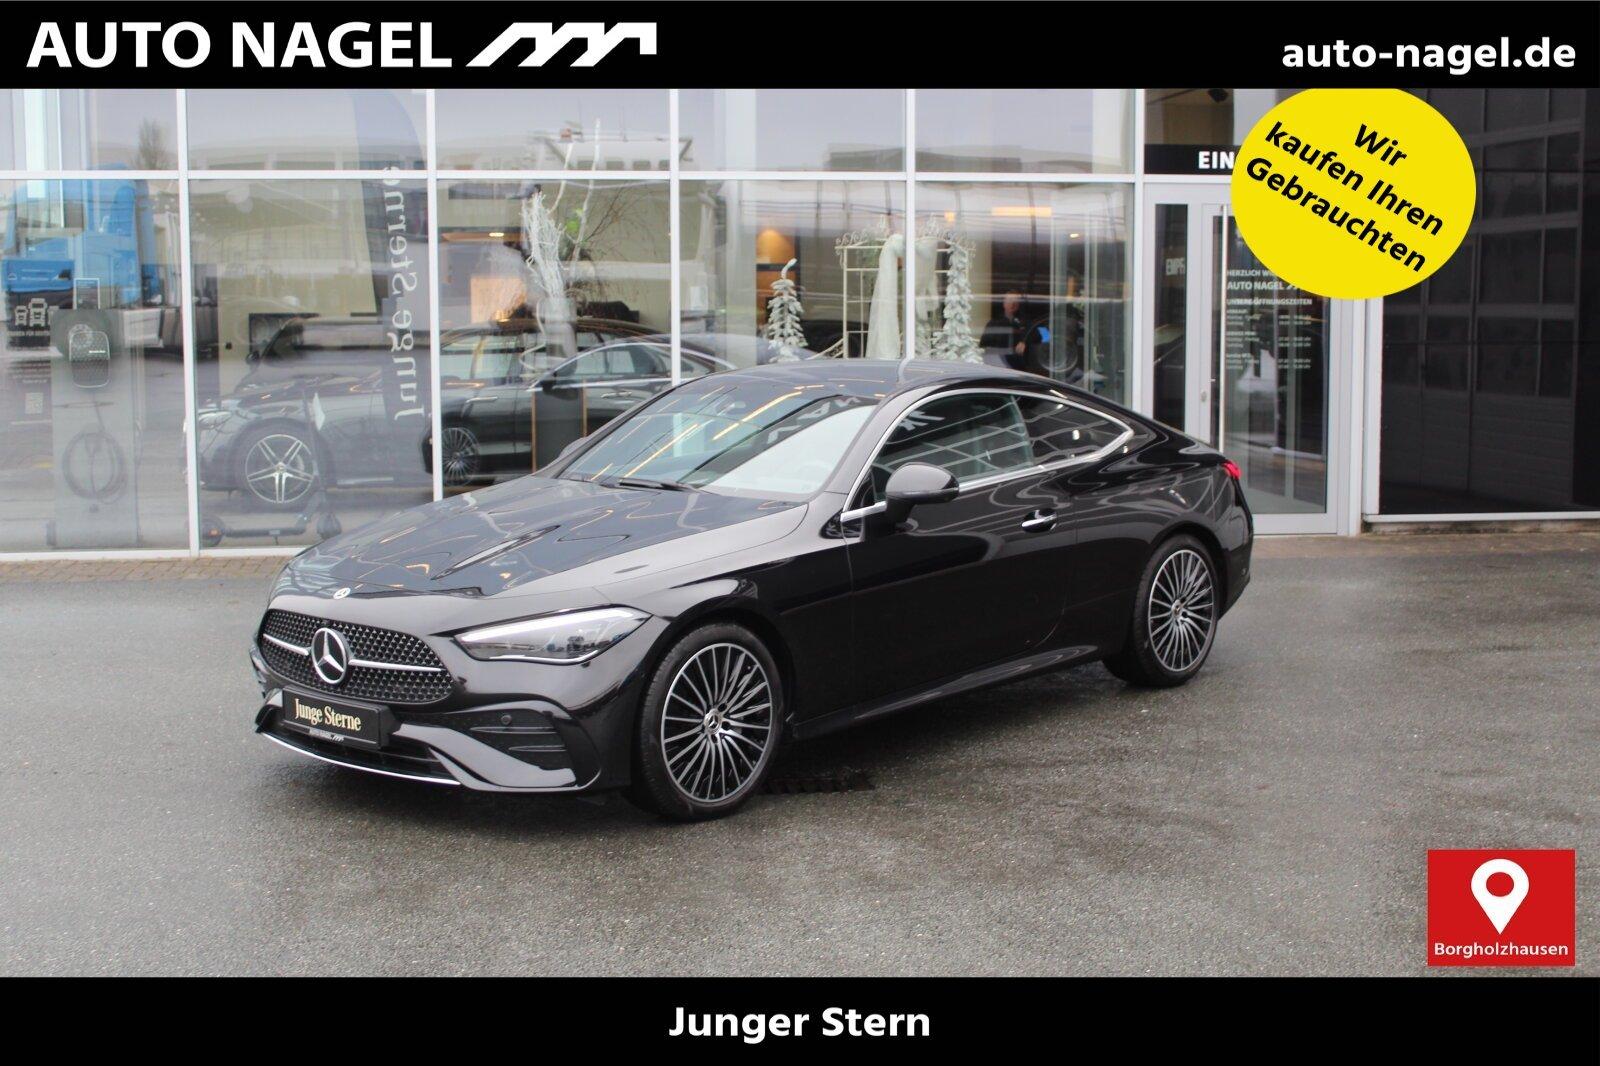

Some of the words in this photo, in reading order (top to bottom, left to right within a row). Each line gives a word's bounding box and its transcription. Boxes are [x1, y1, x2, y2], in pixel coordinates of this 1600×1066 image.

[1227, 281, 1253, 290] AUTO
[1254, 281, 1285, 290] NAGEL
[294, 698, 324, 726] Junge
[324, 705, 362, 732] Sterne
